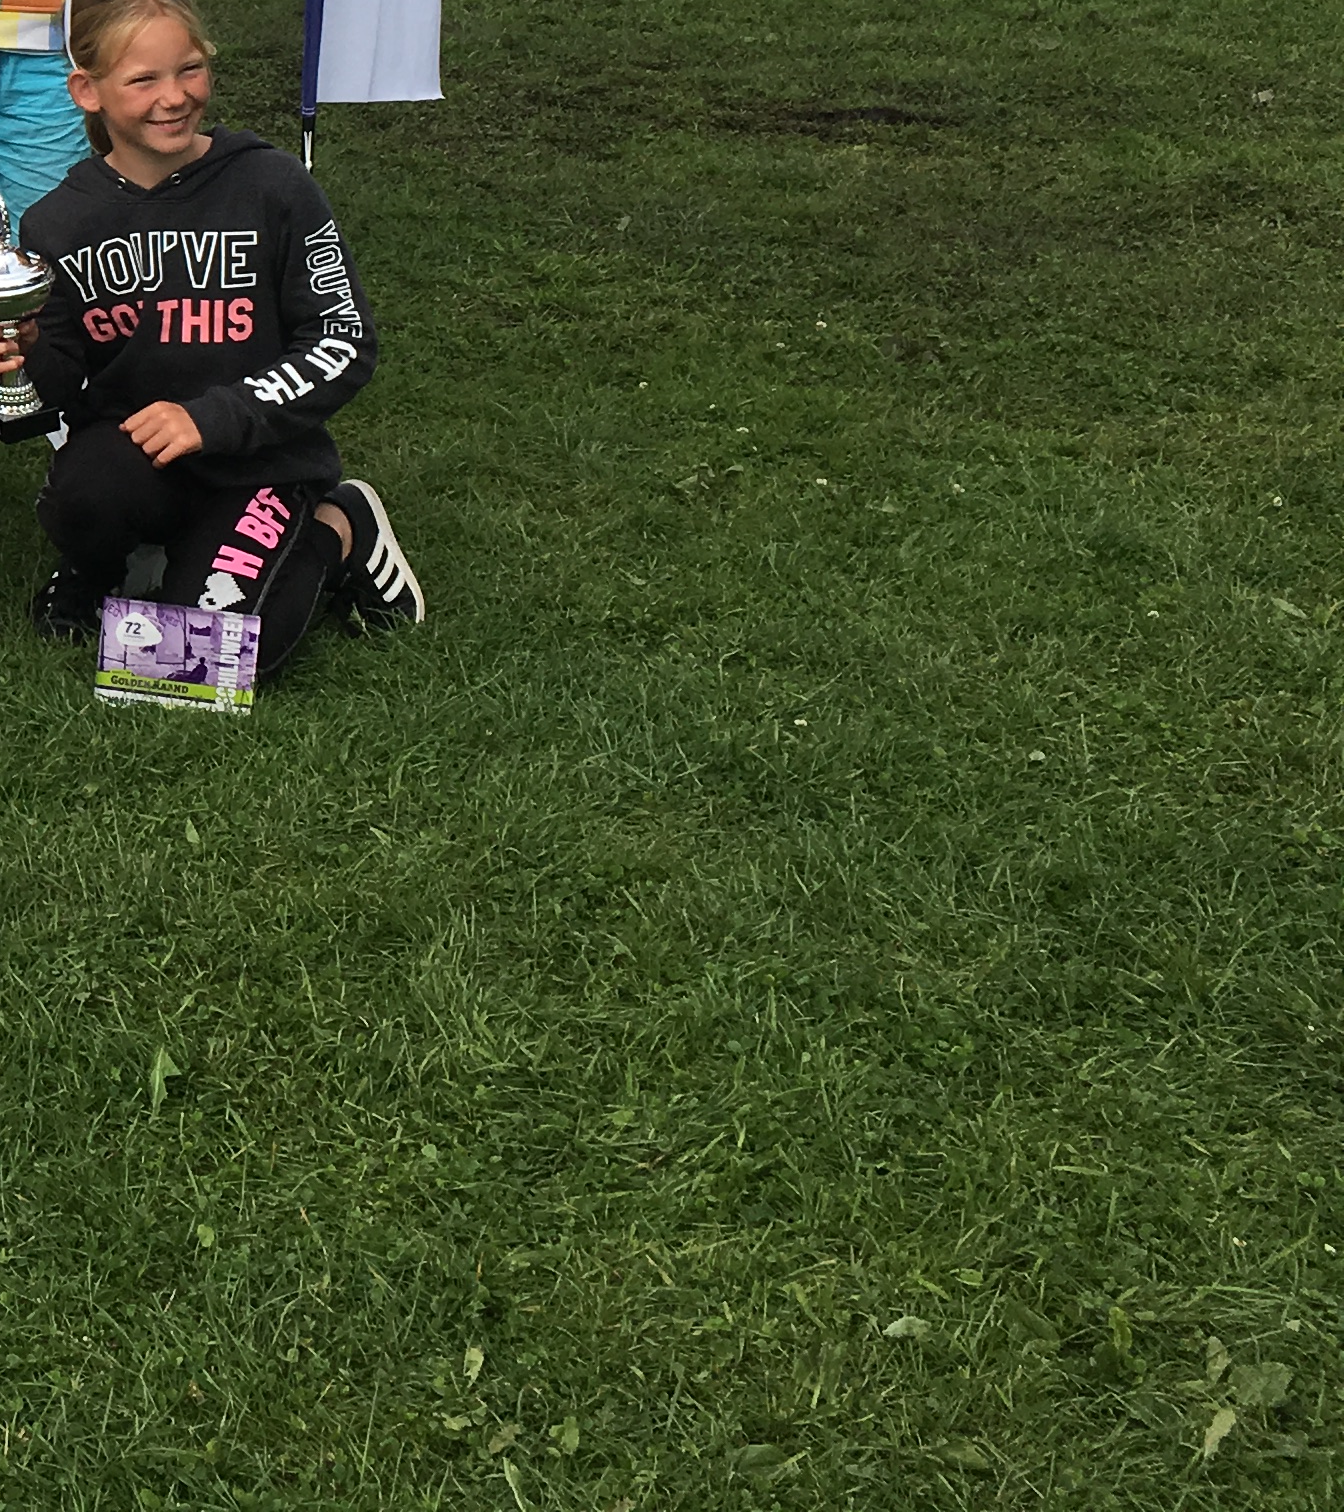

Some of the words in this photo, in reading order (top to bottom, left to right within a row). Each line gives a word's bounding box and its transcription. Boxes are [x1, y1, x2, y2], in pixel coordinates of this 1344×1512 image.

[58, 230, 258, 303] YOU'VE
[304, 219, 362, 338] YOU'VE
[82, 300, 144, 343] GO
[156, 297, 254, 344] THIS
[234, 487, 291, 550] BFF
[124, 621, 141, 635] 72
[110, 674, 152, 688] GOLDEN
